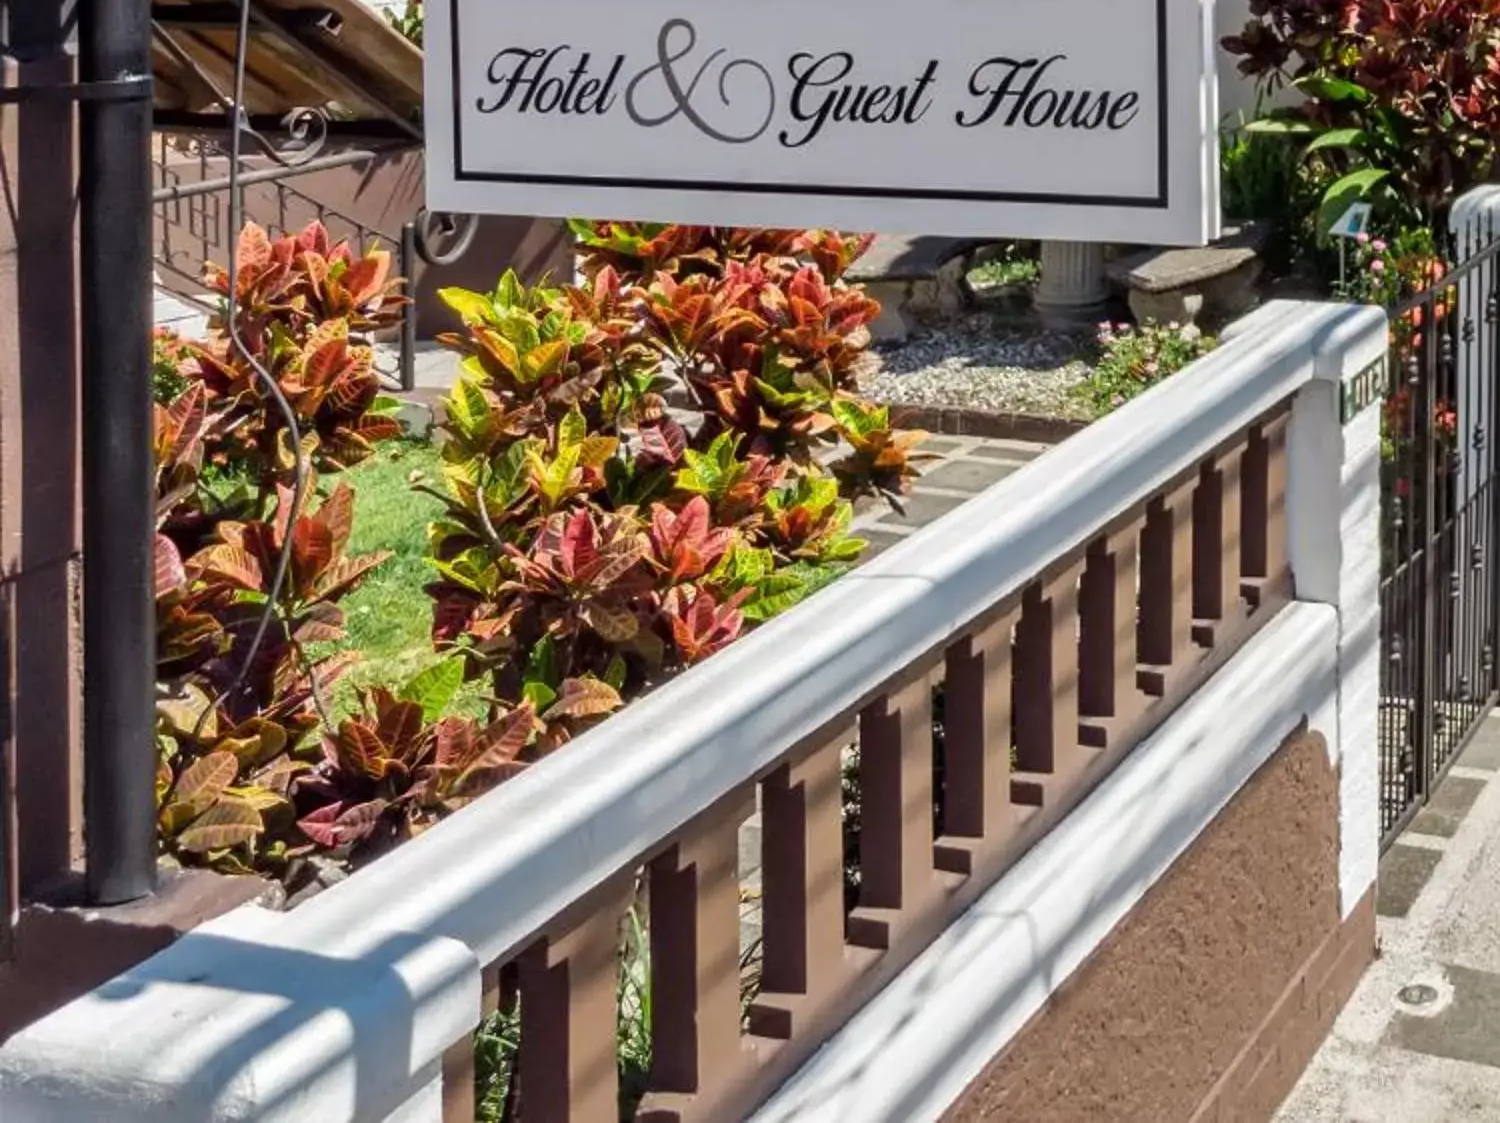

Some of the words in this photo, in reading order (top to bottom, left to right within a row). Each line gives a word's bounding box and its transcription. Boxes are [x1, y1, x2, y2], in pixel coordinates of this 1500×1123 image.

[476, 43, 627, 115] Hotel
[624, 18, 776, 144] &
[778, 51, 940, 148] Guest
[955, 53, 1140, 129] House
